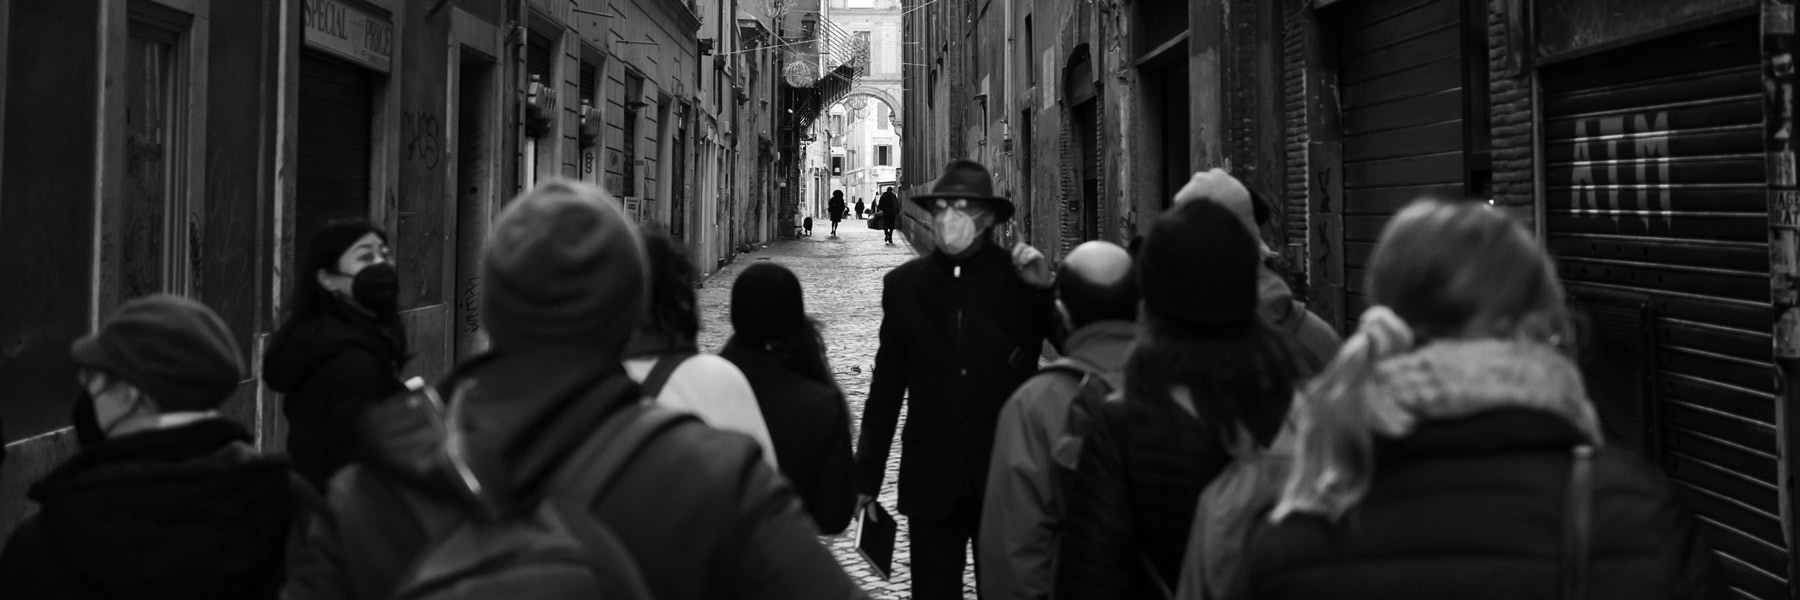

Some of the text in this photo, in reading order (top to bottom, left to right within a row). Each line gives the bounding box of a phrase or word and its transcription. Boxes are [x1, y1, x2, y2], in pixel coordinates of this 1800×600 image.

[304, 0, 391, 56] SPECIAL PRICE
[1570, 110, 1672, 226] ATM
